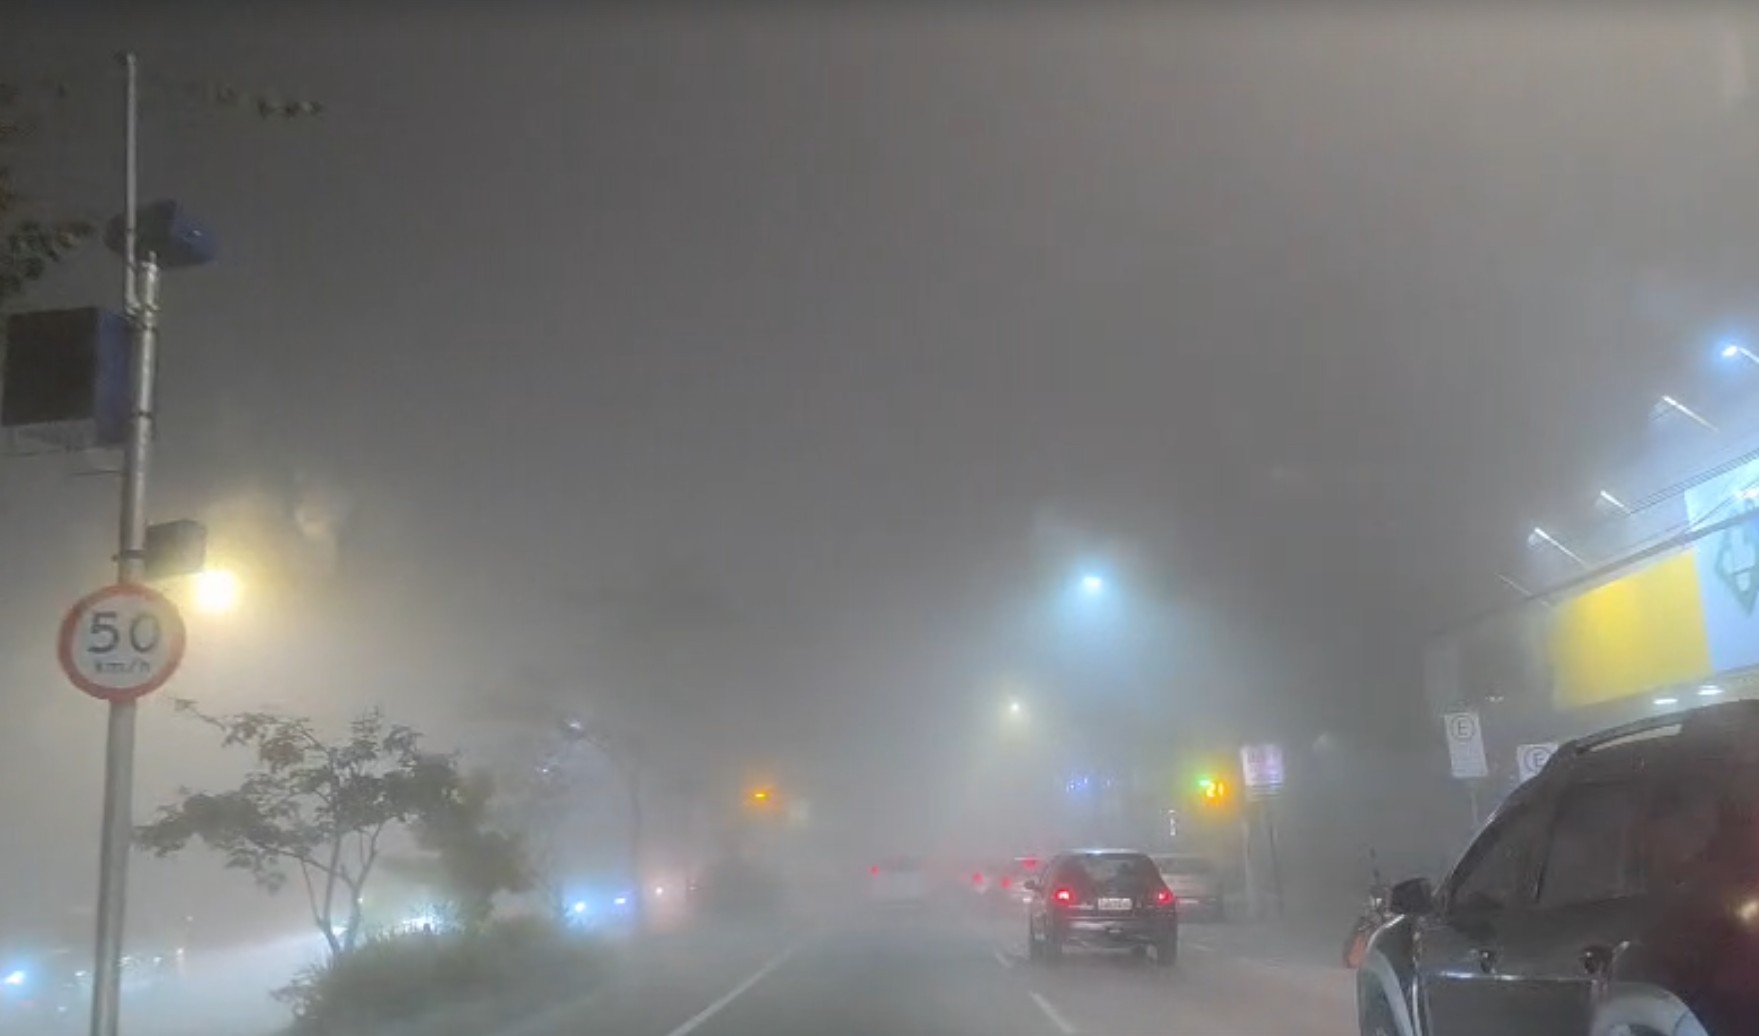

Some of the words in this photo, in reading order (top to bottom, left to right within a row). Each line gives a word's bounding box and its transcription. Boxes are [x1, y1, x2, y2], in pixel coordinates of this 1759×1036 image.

[87, 611, 161, 653] 50
[94, 659, 150, 674] km/h
[1457, 719, 1470, 738] E
